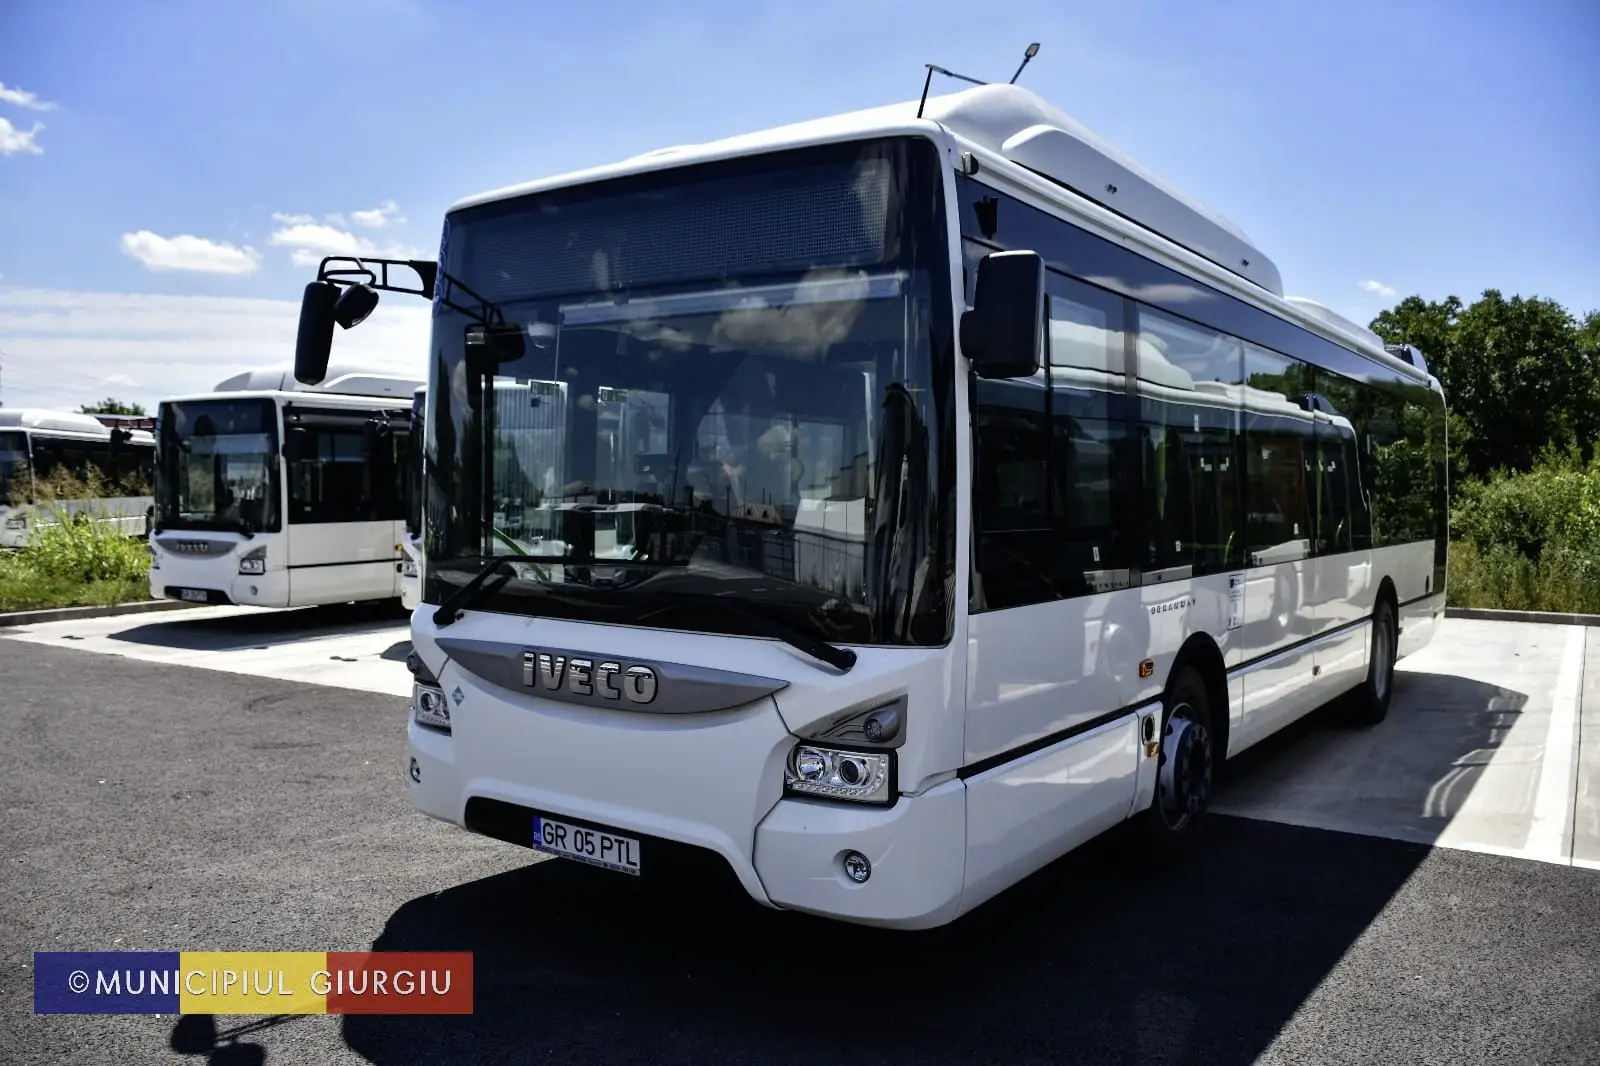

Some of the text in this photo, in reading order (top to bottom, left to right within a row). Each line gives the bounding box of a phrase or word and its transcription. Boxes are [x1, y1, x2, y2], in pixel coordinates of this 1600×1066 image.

[522, 651, 658, 704] IVECO
[543, 822, 567, 849] GR
[574, 829, 595, 856] 05
[601, 835, 638, 867] PTL
